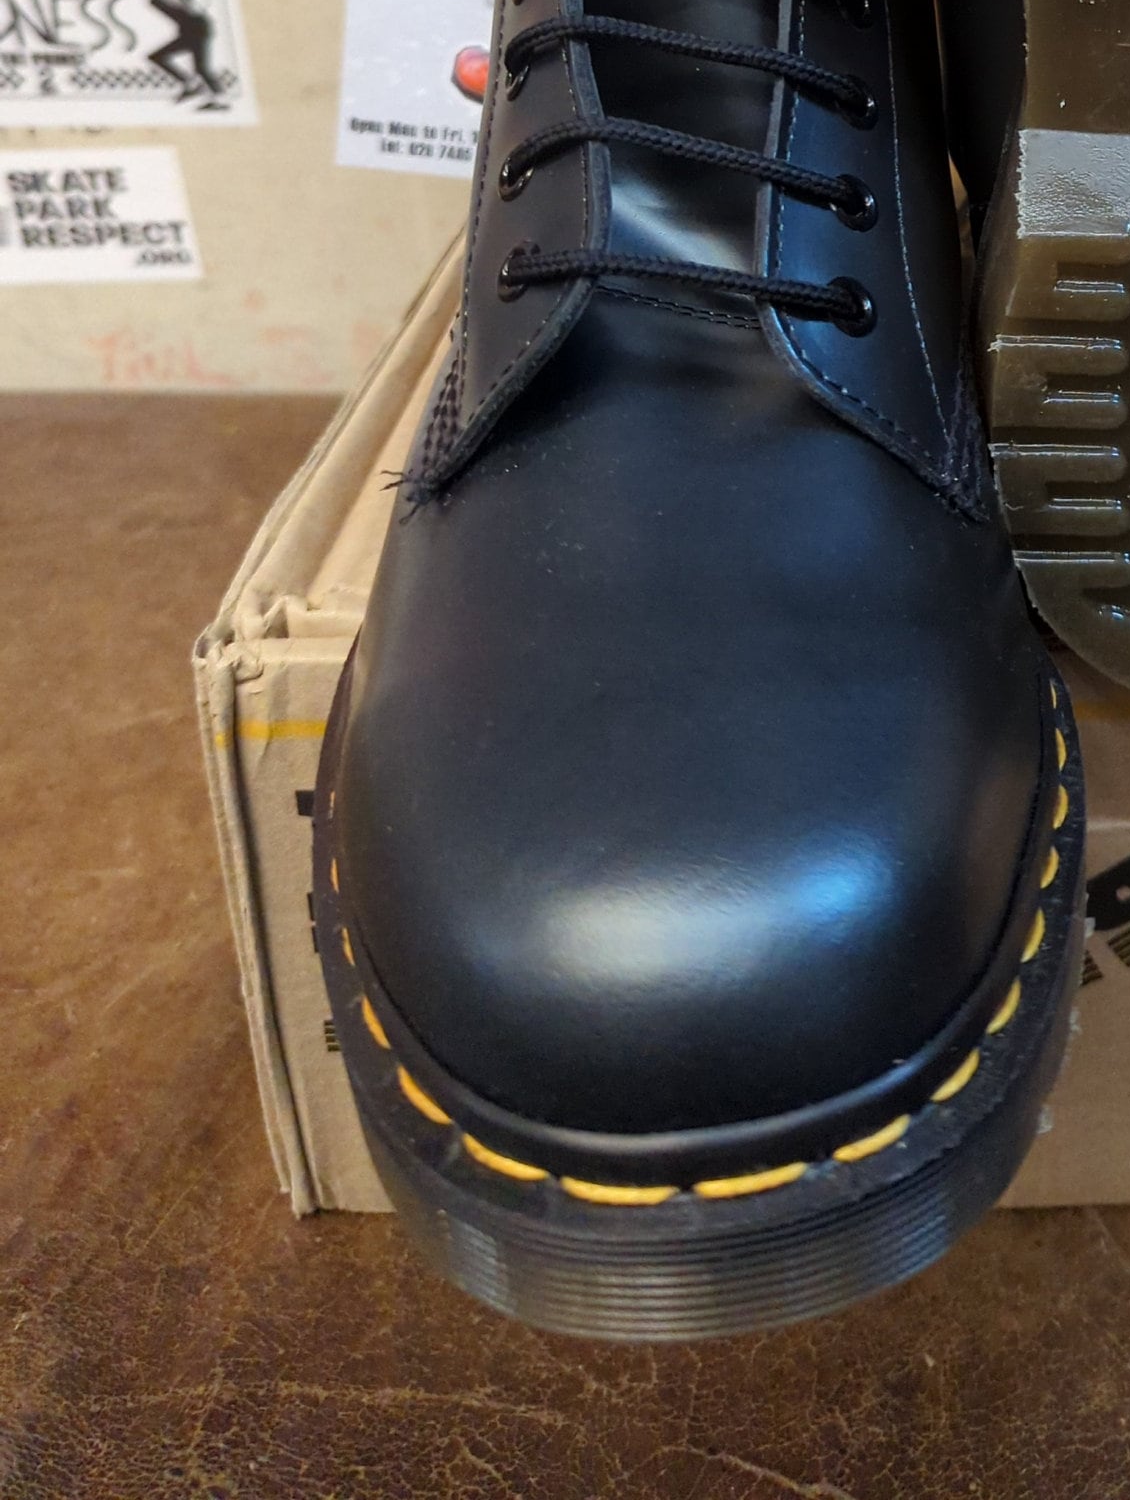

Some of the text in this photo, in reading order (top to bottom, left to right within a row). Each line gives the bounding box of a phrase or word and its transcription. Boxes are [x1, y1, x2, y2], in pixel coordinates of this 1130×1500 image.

[6, 167, 128, 193] SKATE
[14, 194, 117, 220] PARK
[20, 220, 188, 249] RESPECT
